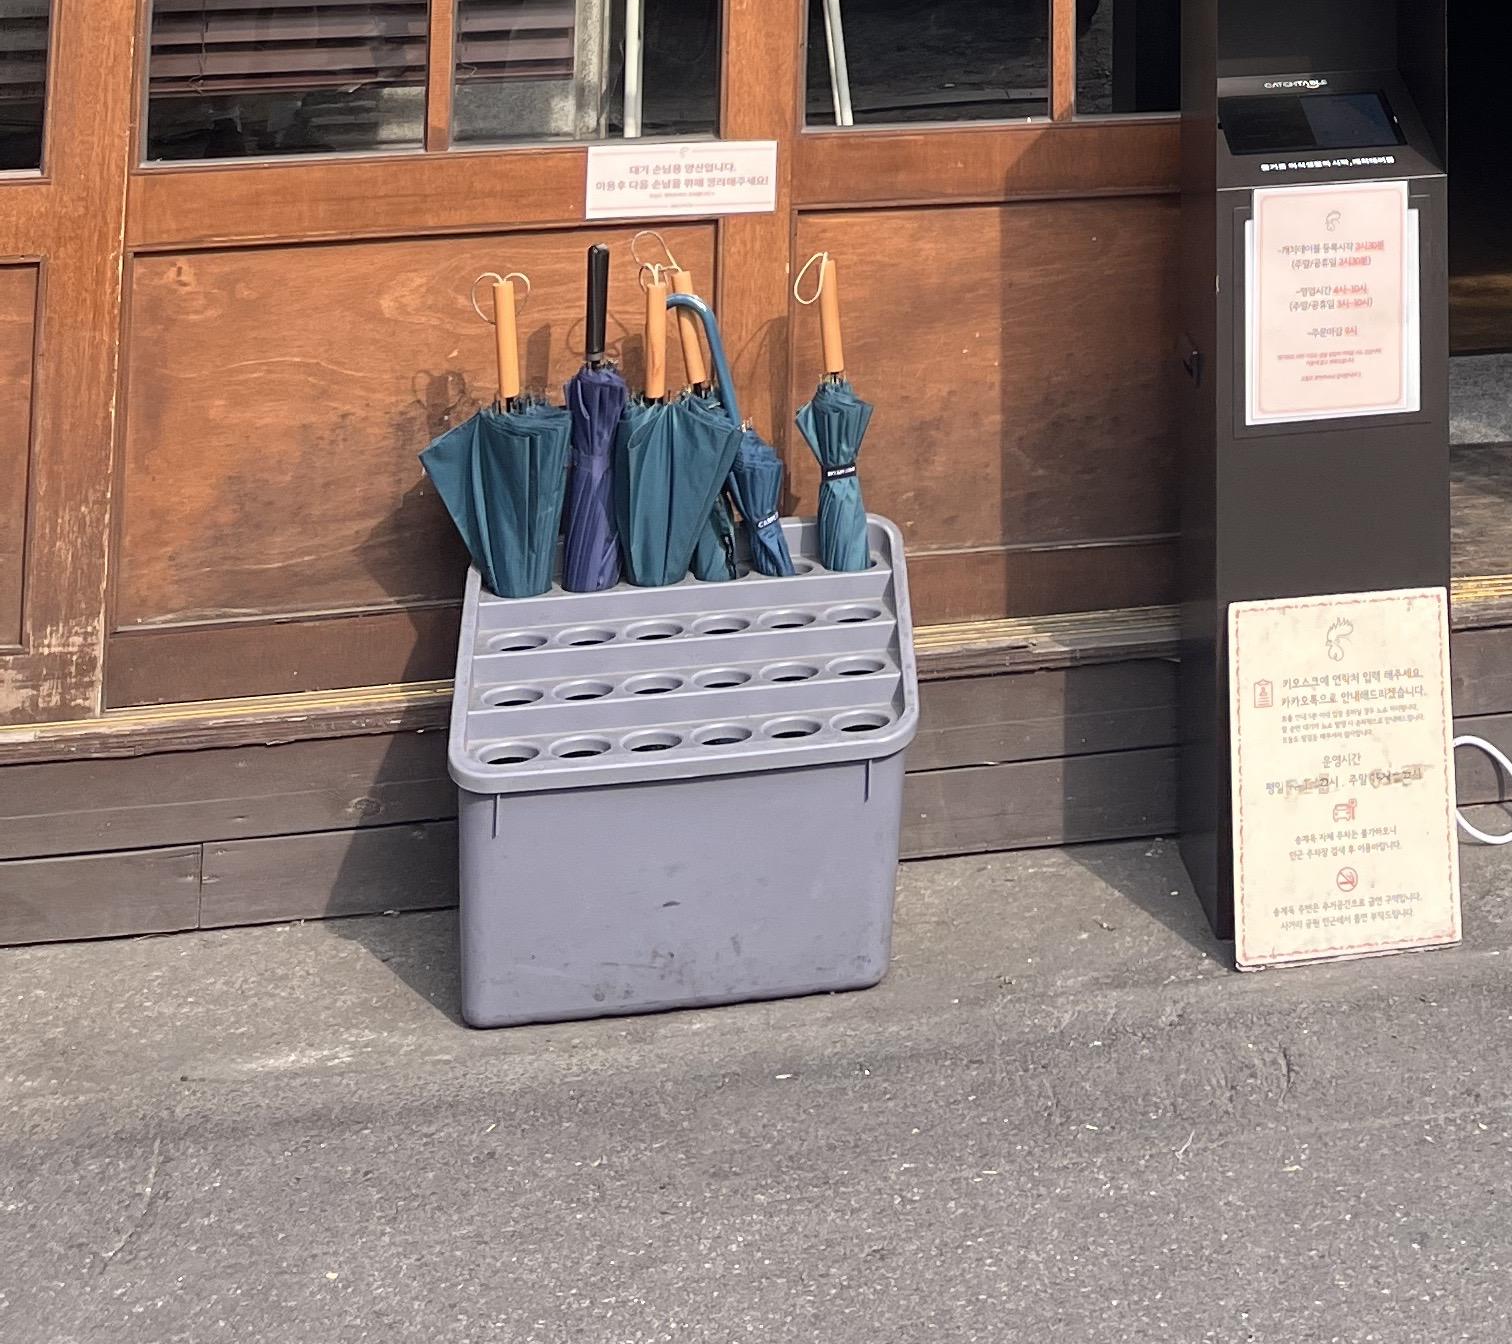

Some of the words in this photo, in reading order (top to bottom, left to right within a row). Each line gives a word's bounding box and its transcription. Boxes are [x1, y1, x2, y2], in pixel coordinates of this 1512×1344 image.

[629, 165, 649, 175] 대기
[1282, 675, 1330, 690] 키오스크에
[1332, 672, 1360, 687] 연락처
[1362, 670, 1381, 684] 입력
[1281, 693, 1337, 708] 카카오톡으로
[1322, 752, 1362, 769] 운영시간
